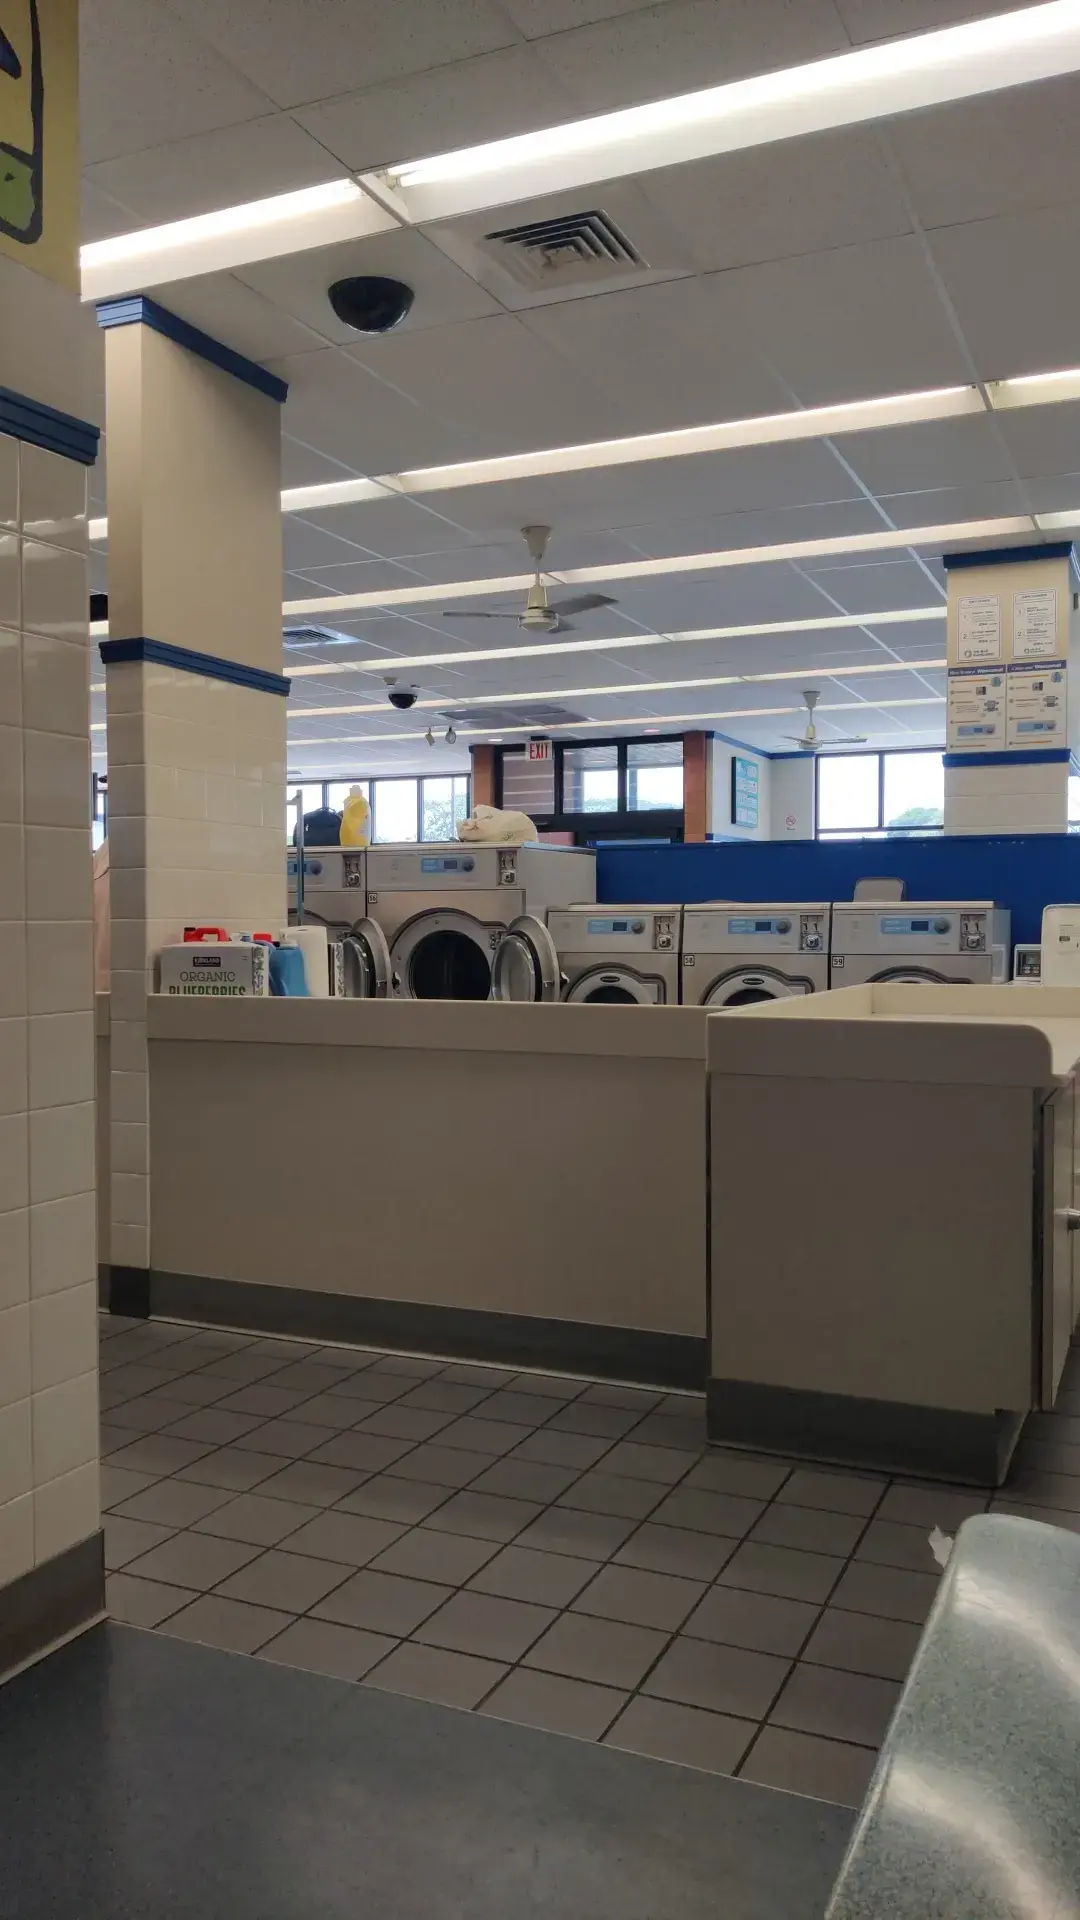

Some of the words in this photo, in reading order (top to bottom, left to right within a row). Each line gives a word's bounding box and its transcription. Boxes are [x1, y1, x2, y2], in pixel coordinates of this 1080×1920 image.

[529, 742, 549, 760] EXIT
[833, 958, 843, 966] 59
[179, 971, 236, 982] ORGANIC
